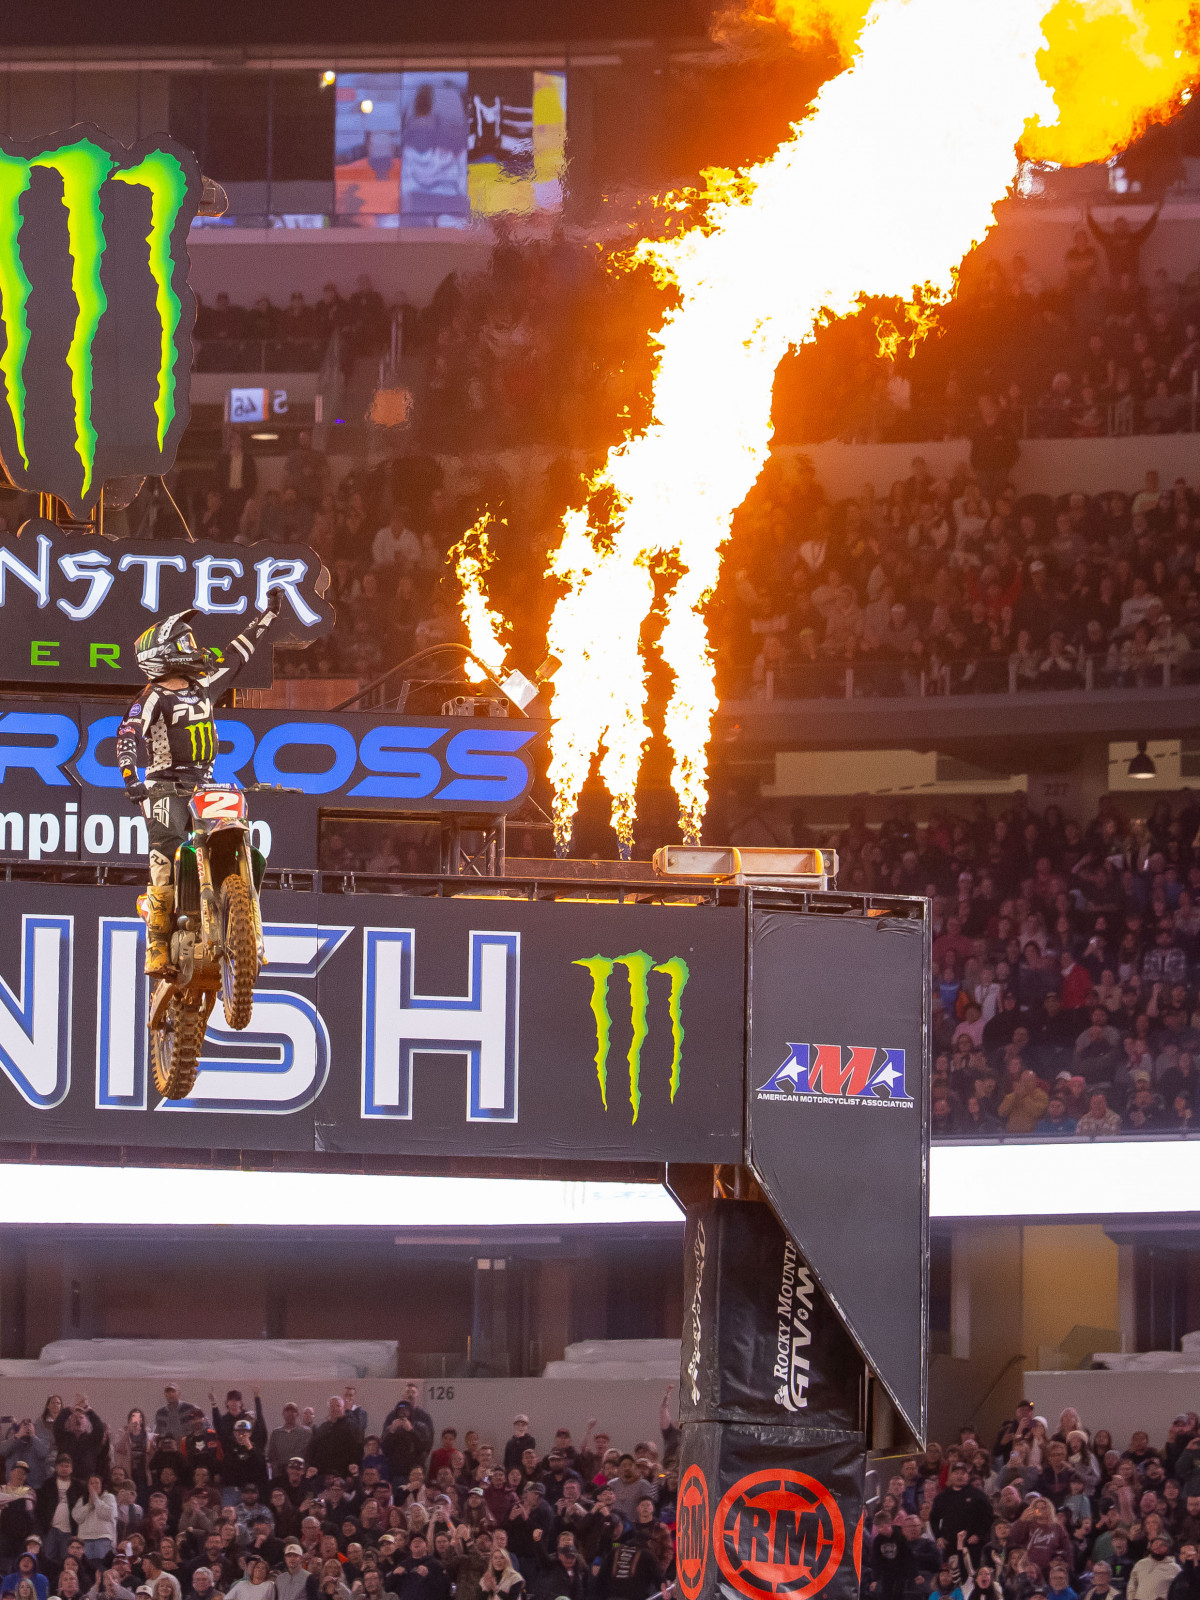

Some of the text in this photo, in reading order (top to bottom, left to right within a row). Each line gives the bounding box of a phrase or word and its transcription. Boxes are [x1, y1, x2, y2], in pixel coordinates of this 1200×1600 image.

[172, 698, 211, 725] FLY
[201, 792, 239, 819] 2
[756, 1042, 914, 1100] AMA
[757, 1093, 914, 1108] AMERICAN MOTORCYCLIST ASSOCIATION
[774, 1241, 797, 1382] ROCKY MOUNTA
[428, 1386, 455, 1400] 126
[738, 1506, 821, 1568] RM
